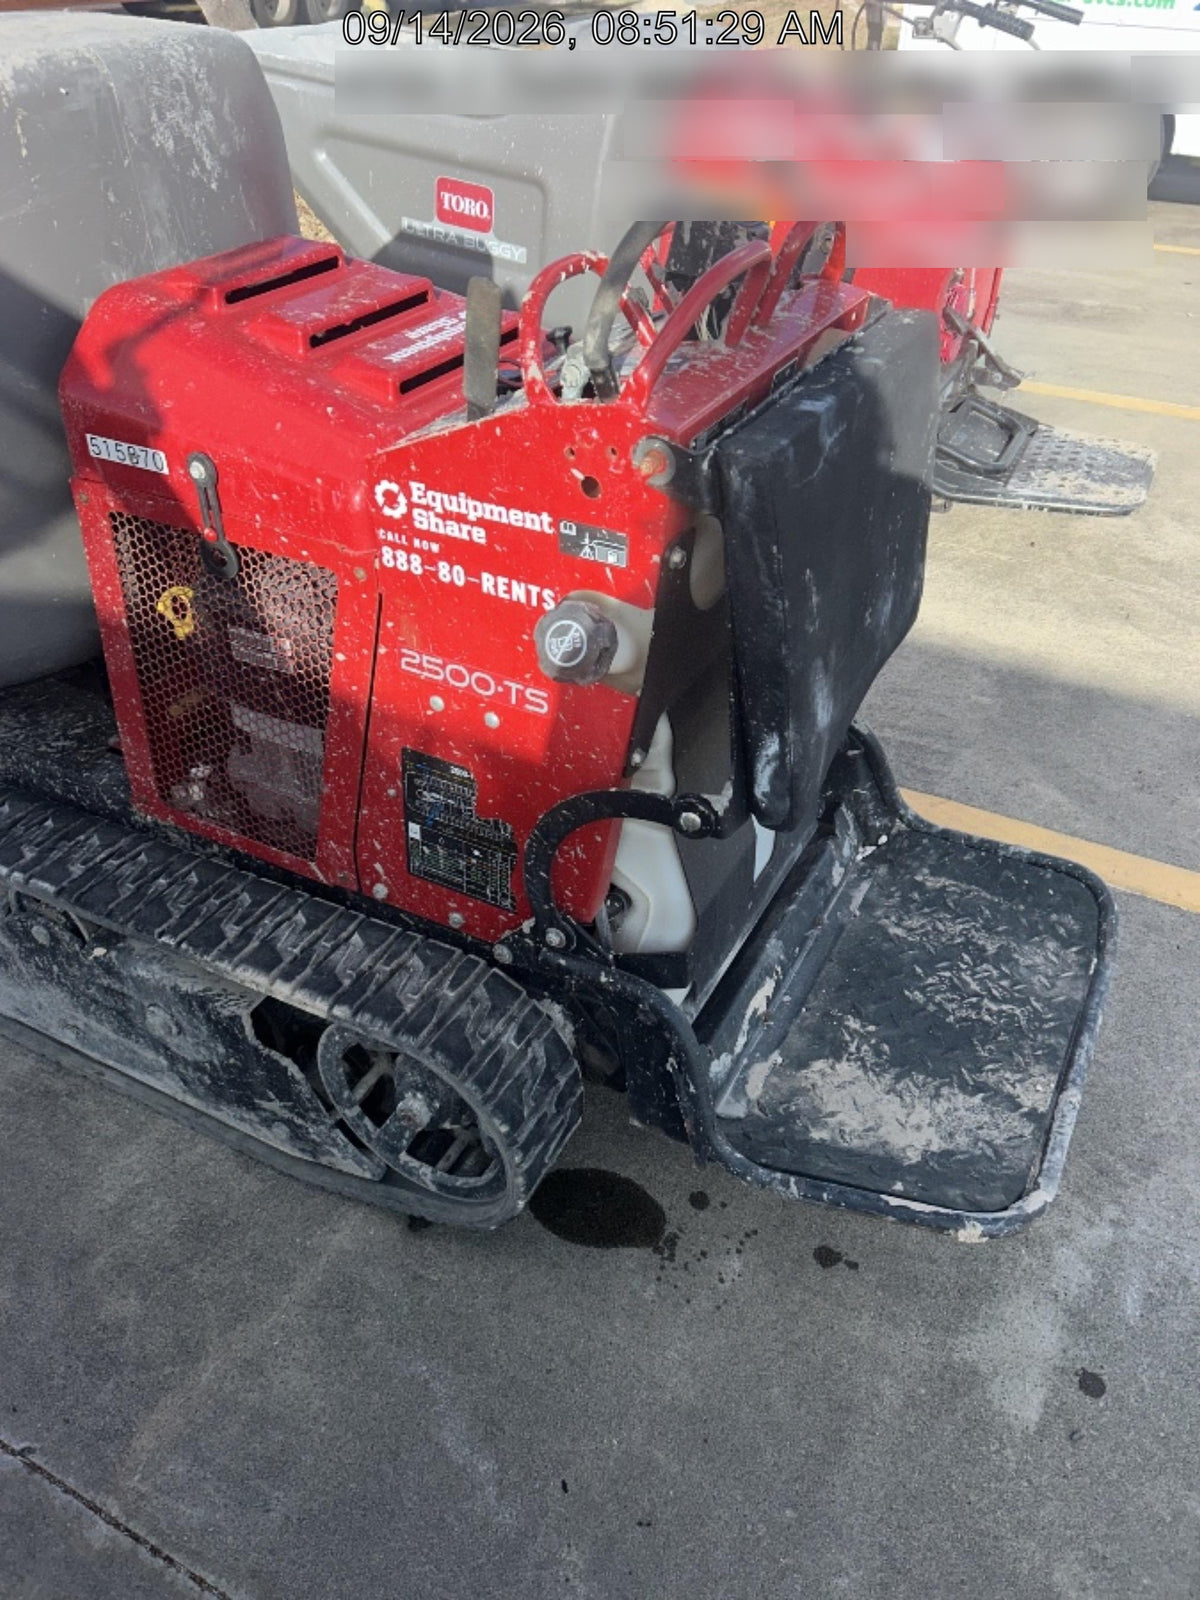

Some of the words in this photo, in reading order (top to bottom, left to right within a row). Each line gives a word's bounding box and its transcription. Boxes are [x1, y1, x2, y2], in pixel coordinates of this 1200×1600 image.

[441, 192, 490, 218] TORO
[403, 219, 458, 243] ULTRA
[464, 235, 523, 261] BUGGY
[409, 481, 555, 534] Equipment
[412, 508, 487, 544] Share
[378, 528, 408, 545] CALL
[413, 537, 440, 553] NOW
[381, 545, 556, 611] 888-80-RENTS
